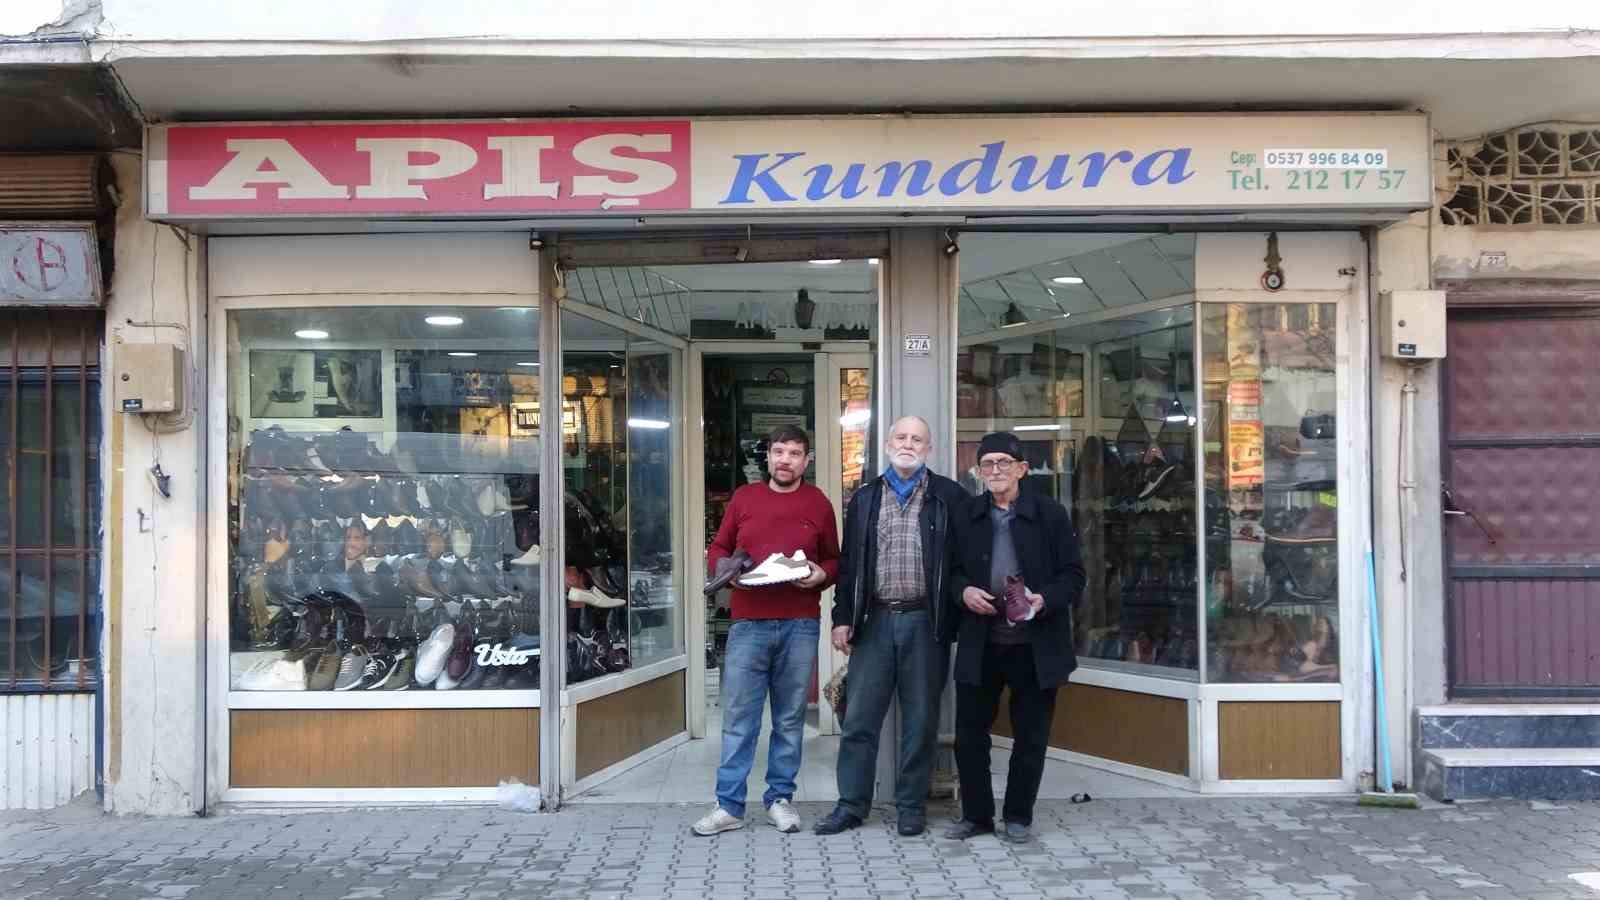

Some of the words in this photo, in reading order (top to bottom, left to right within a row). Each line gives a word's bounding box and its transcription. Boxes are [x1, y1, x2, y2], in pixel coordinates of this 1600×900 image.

[1267, 152, 1303, 165] 0537
[1308, 152, 1337, 165] 996
[1341, 152, 1360, 165] 84
[1364, 152, 1384, 165] 09
[188, 132, 678, 210] APIŞ
[718, 141, 1194, 204] Kundura
[1226, 168, 1270, 190] Tel.
[1286, 169, 1329, 190] 212
[1340, 169, 1368, 190] 17
[1377, 169, 1407, 190] 57
[907, 339, 929, 350] 27/A
[474, 643, 541, 667] Usta
